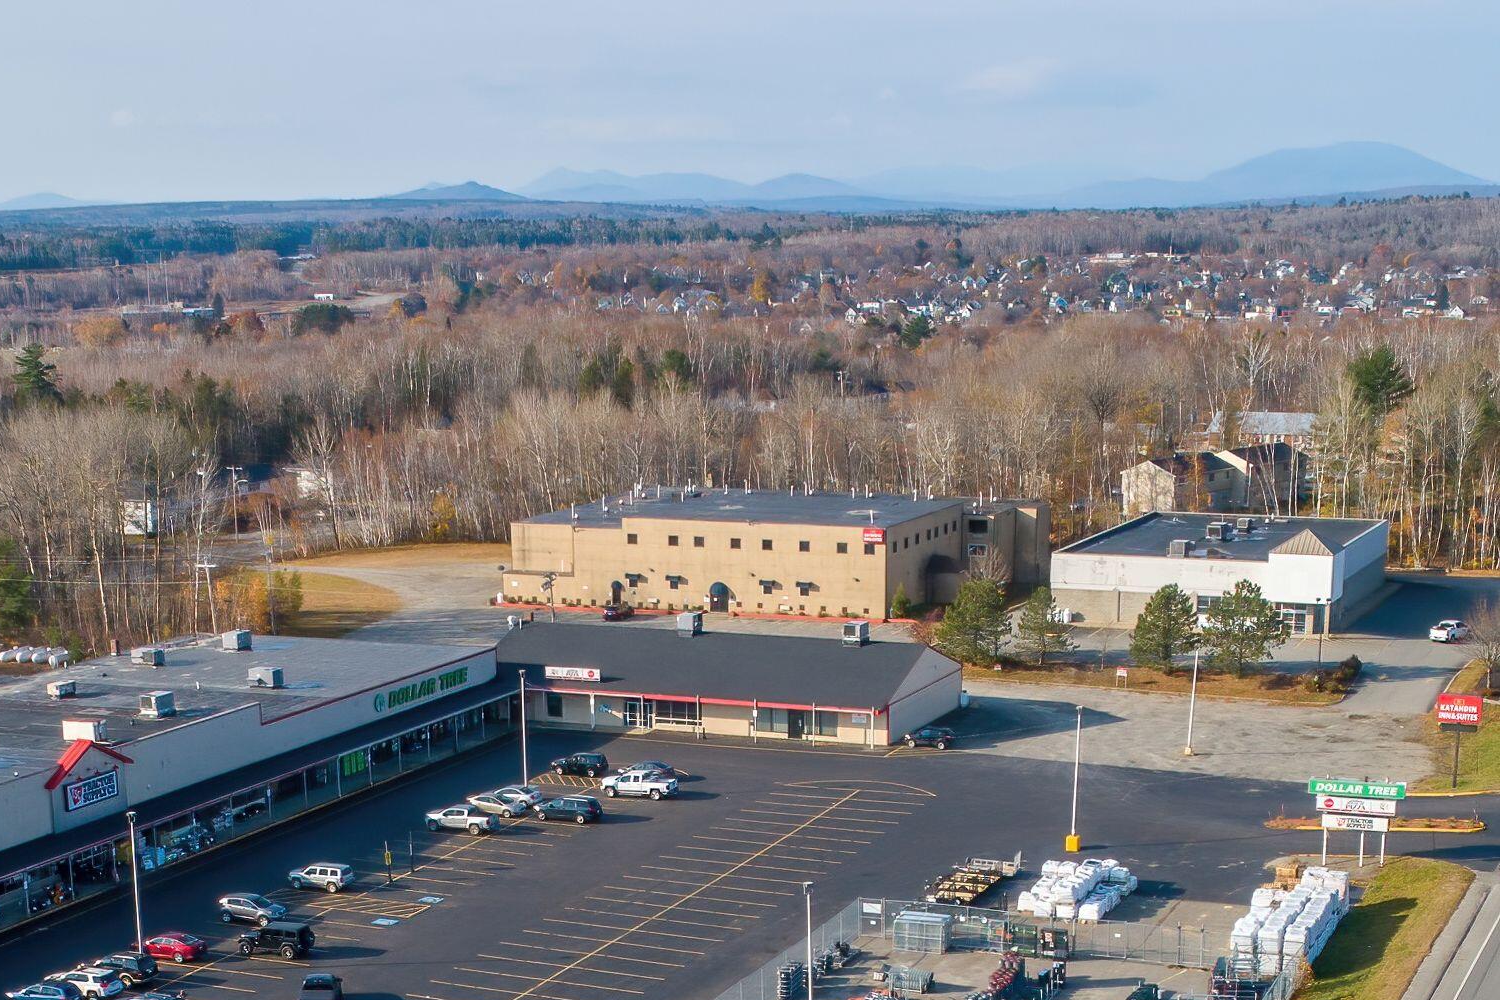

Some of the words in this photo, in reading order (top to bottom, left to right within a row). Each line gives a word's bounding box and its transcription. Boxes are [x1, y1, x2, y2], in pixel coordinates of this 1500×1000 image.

[388, 677, 437, 709] DOLLAR
[438, 666, 469, 691] TREE
[1439, 704, 1478, 713] KATAHDIN
[1315, 782, 1364, 795] DOLLAR
[1367, 786, 1399, 796] TREE
